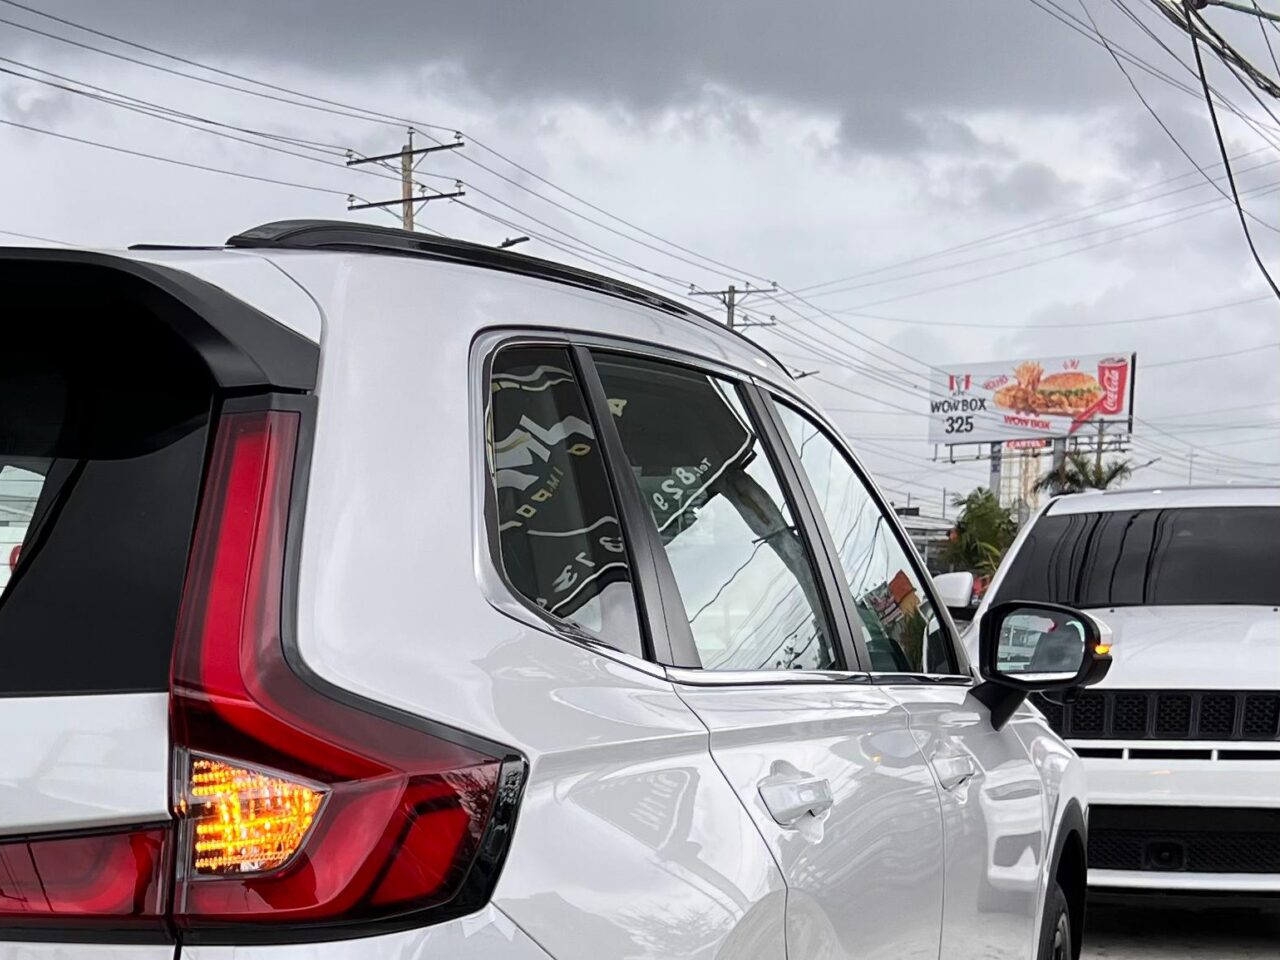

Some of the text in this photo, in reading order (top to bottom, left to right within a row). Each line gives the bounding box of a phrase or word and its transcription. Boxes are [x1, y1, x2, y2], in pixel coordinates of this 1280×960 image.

[930, 398, 987, 413] WOW BOX
[945, 415, 974, 434] 325
